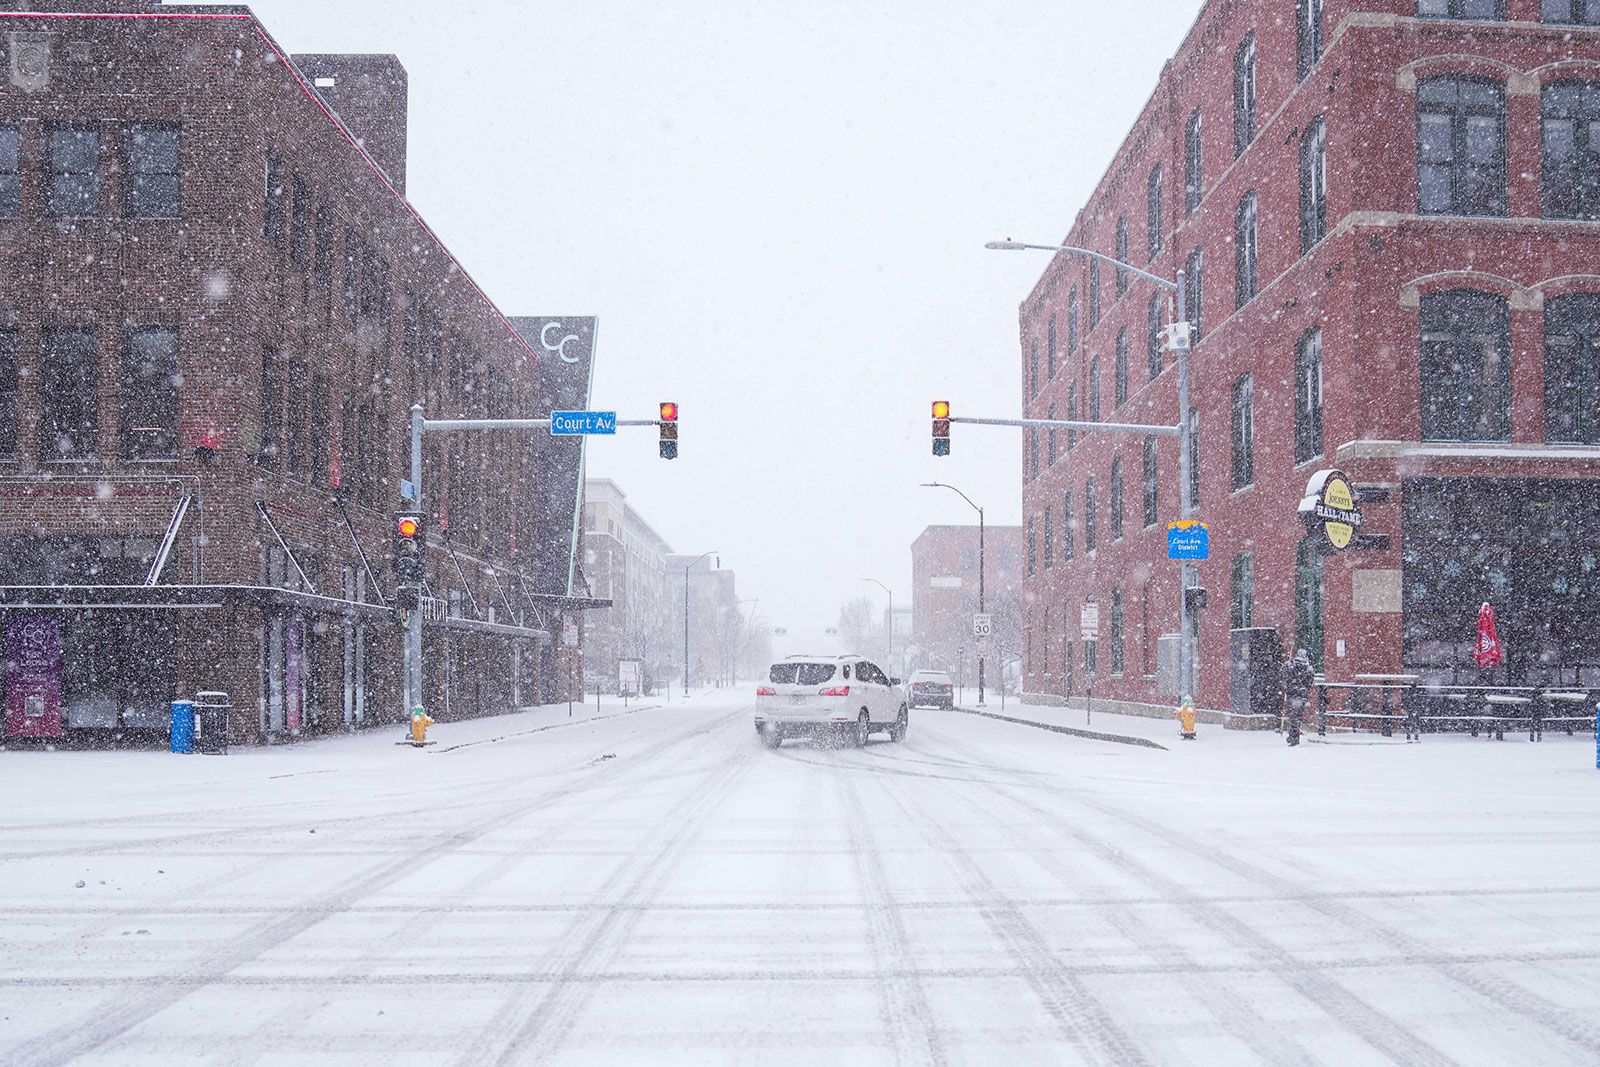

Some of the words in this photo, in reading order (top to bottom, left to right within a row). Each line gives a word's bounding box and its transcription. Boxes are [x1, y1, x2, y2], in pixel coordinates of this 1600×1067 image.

[555, 416, 592, 430] Court
[1317, 505, 1338, 519] HALL
[975, 625, 990, 634] 30
